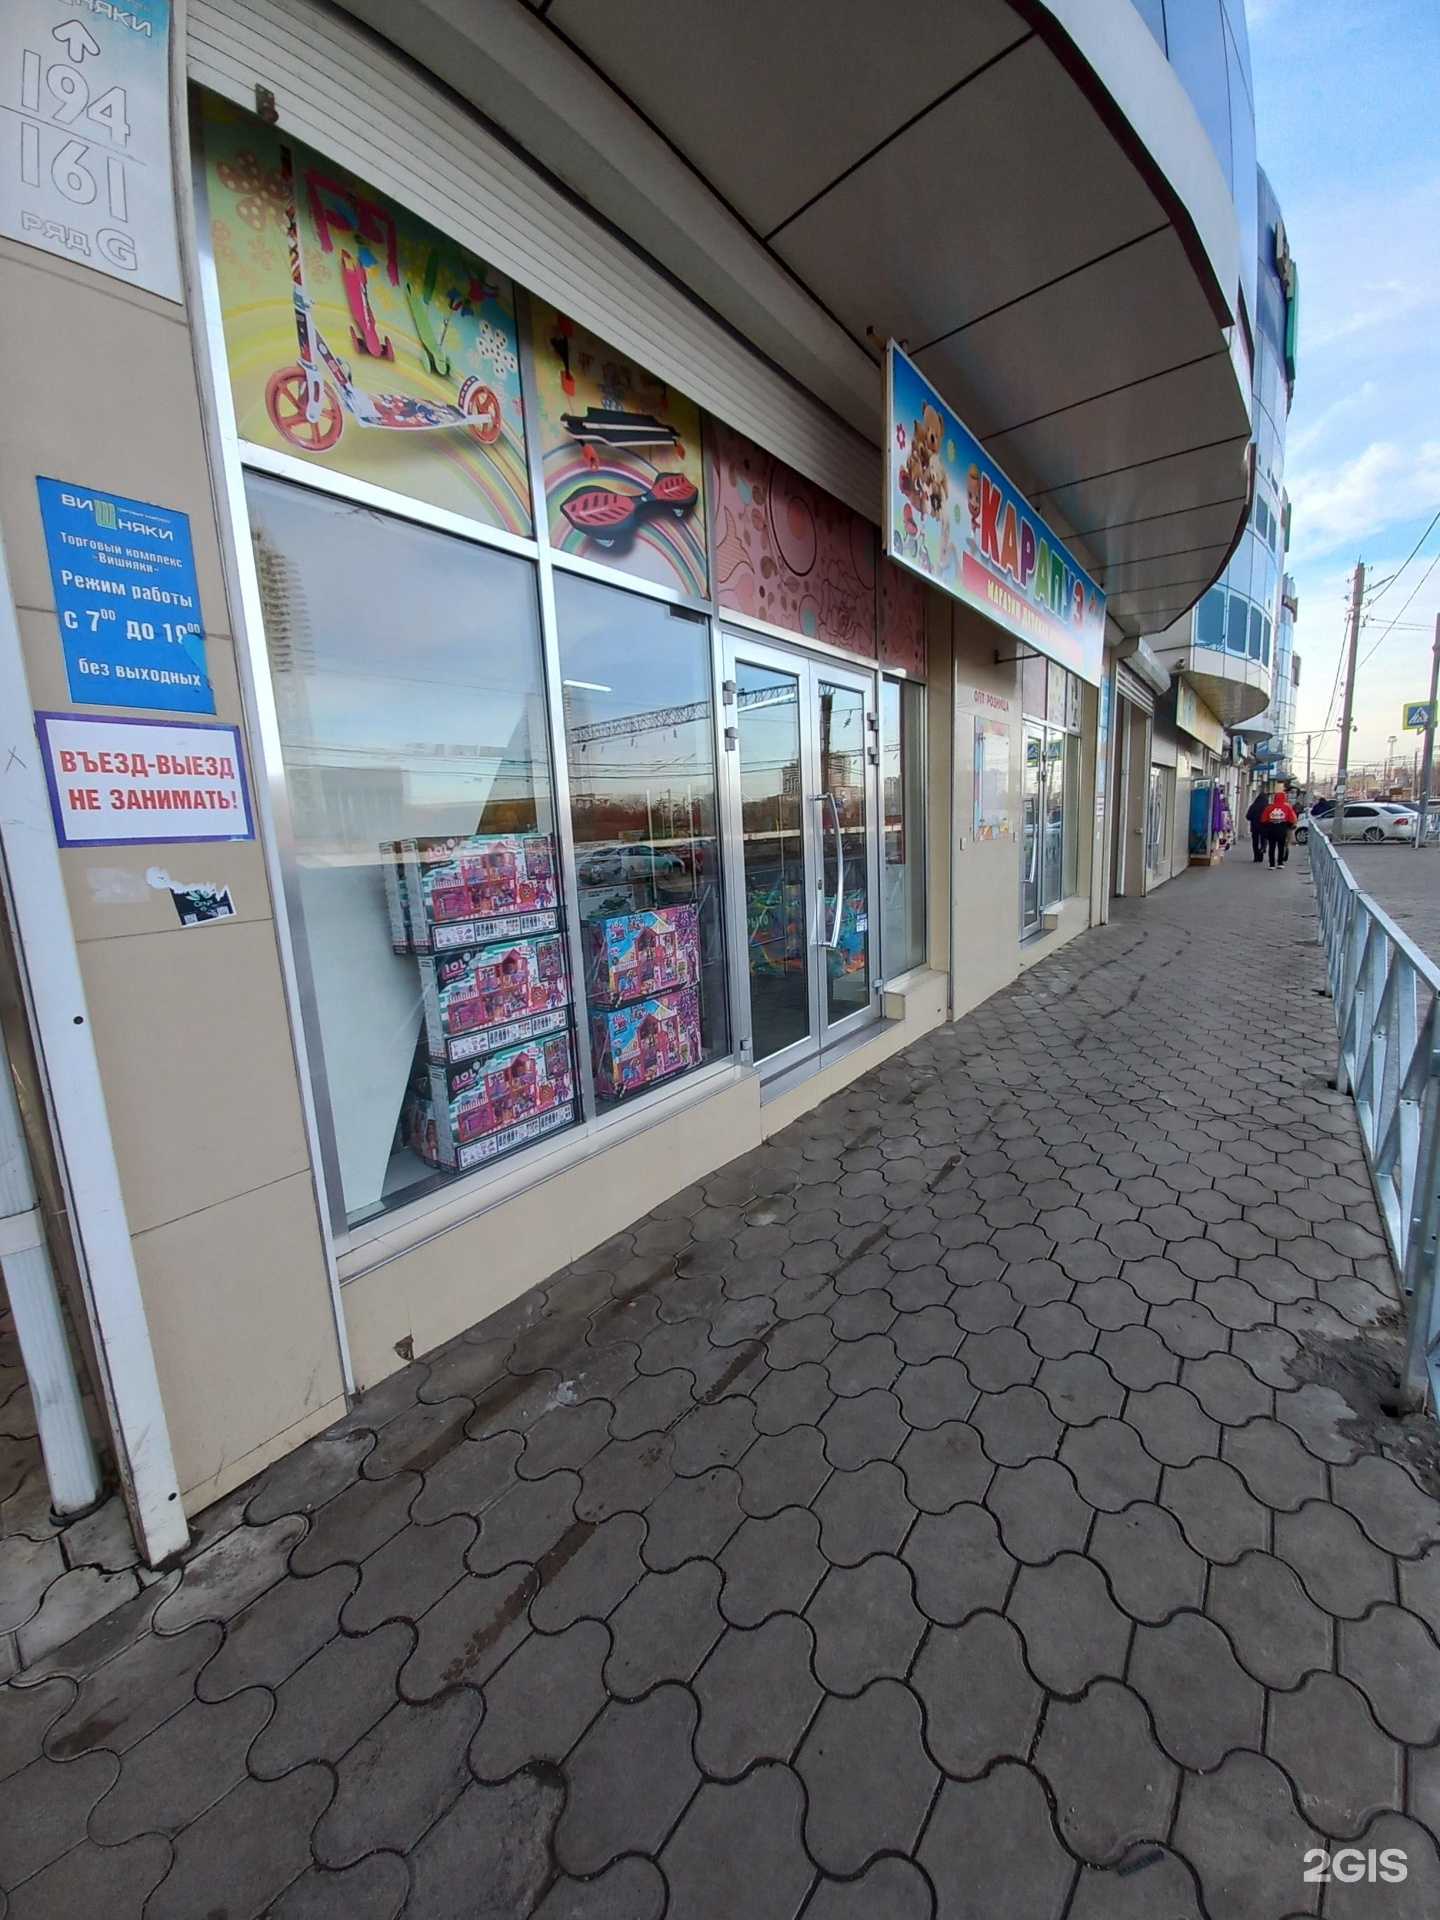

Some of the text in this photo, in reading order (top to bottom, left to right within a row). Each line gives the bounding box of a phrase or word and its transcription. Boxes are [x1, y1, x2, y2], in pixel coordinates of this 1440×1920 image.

[22, 49, 131, 148] 194
[21, 121, 128, 222] 161
[126, 549, 183, 568] комплекс
[979, 472, 1085, 628] КАРАПУЗ
[61, 569, 194, 608] Режим работы
[78, 657, 202, 687] без выходных
[59, 750, 236, 779] ВЪЕЗД-ВЫЕЗД
[68, 788, 239, 811] НЕ ЗАНИМАТЬ!
